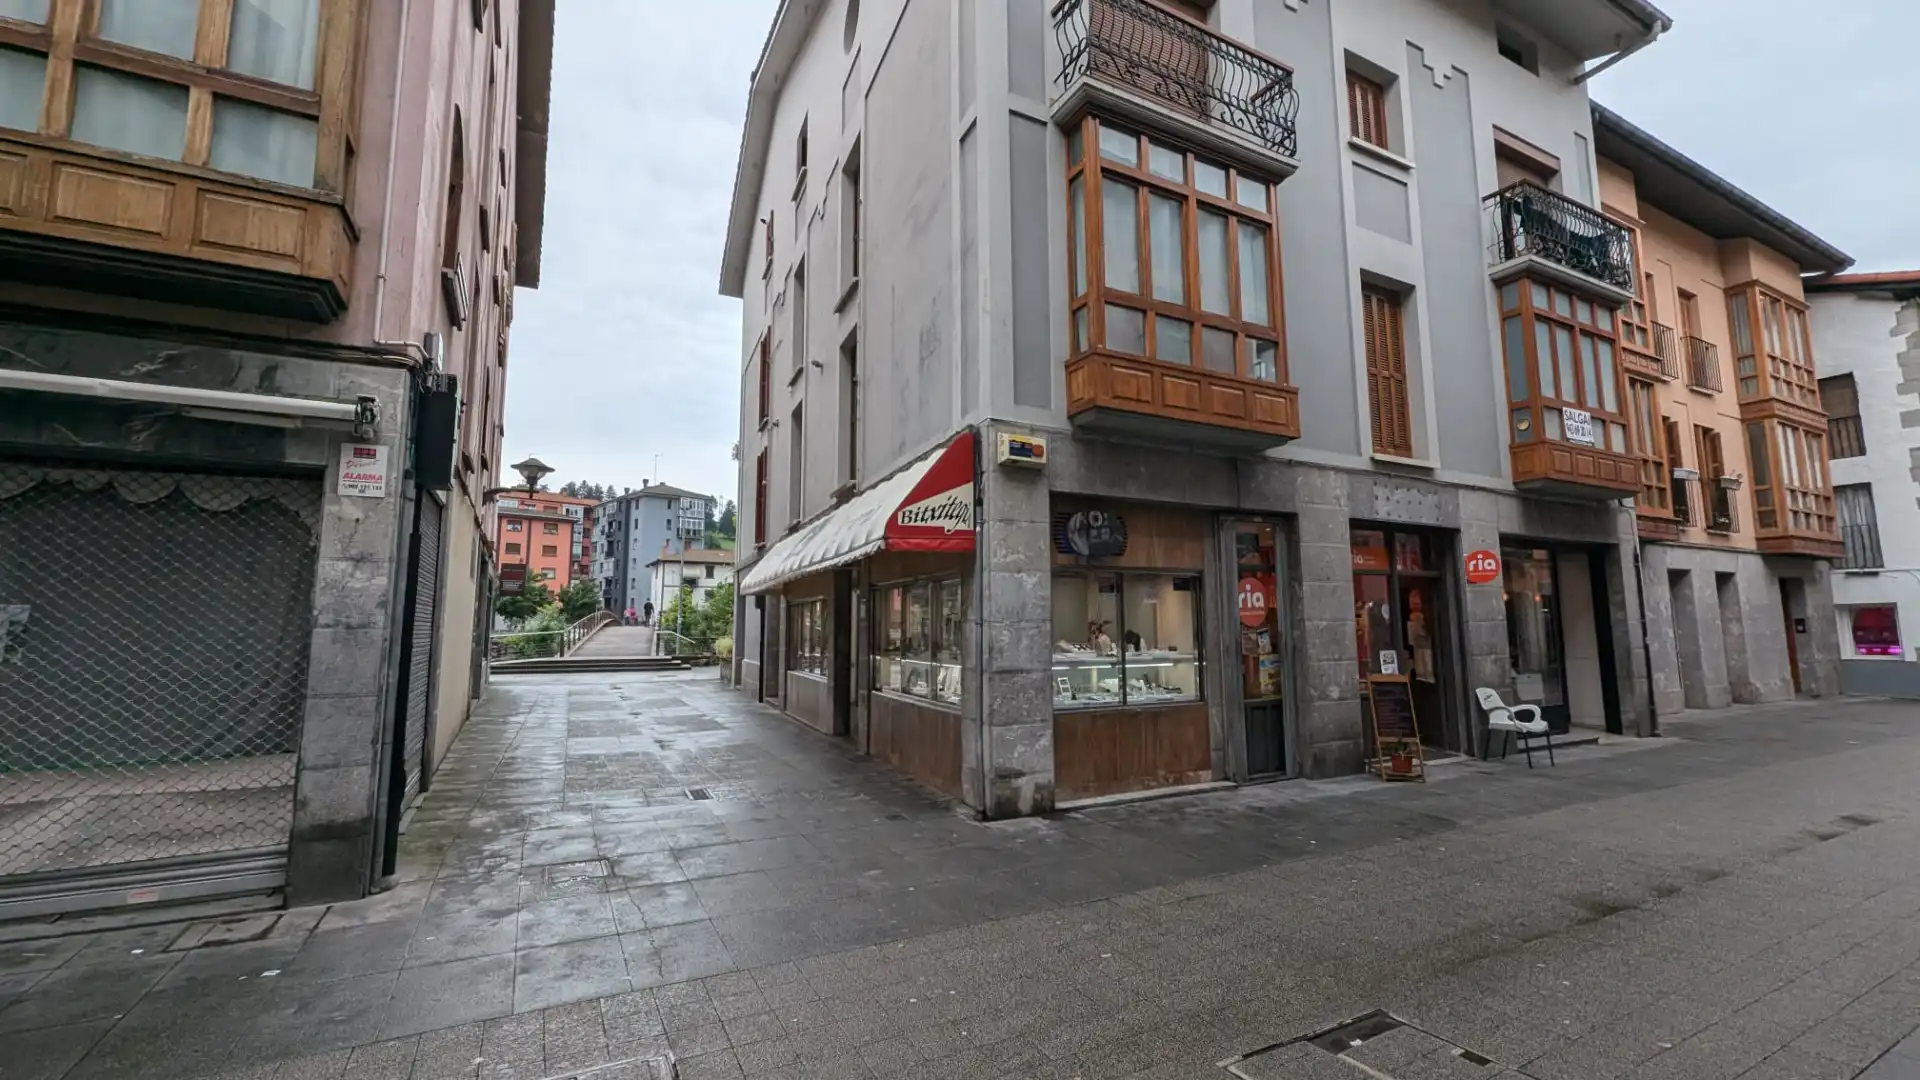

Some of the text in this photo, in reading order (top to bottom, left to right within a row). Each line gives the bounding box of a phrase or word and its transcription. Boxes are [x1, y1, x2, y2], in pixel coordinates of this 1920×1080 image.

[342, 472, 383, 481] ALARMA
[1469, 554, 1496, 571] ria
[1238, 583, 1265, 609] ria
